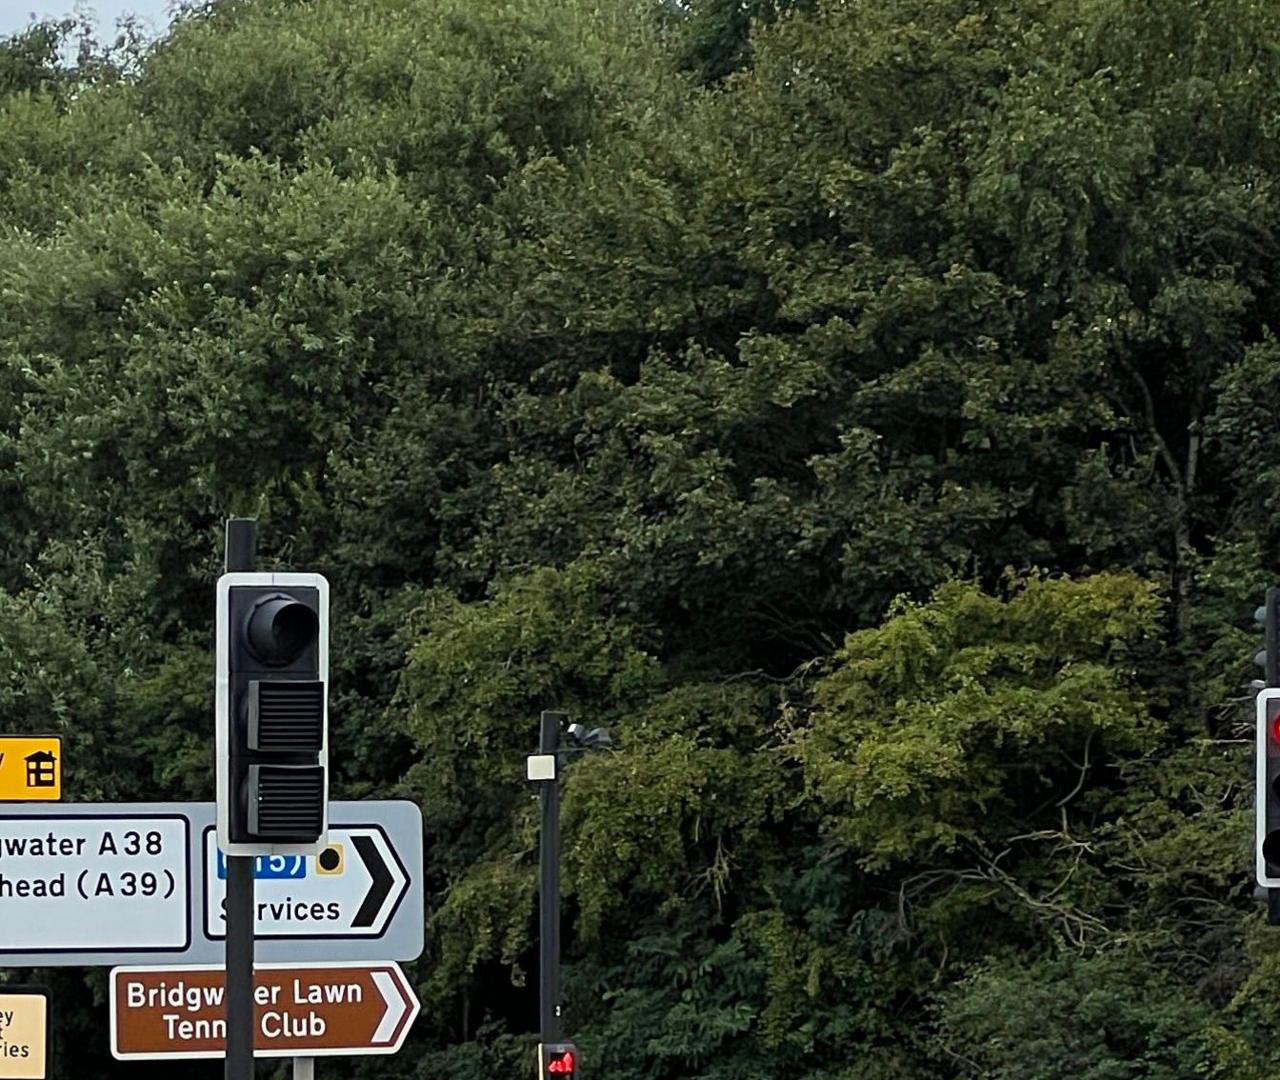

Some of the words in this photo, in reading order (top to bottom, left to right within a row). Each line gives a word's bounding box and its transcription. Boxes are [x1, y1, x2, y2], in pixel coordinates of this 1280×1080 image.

[98, 830, 162, 856] A38
[77, 868, 176, 900] (A39)
[219, 896, 341, 921] rvices
[126, 981, 282, 1012] Bridgwer
[292, 978, 363, 1004] Lawn
[162, 1013, 227, 1040] Tenn
[260, 1010, 327, 1039] Club
